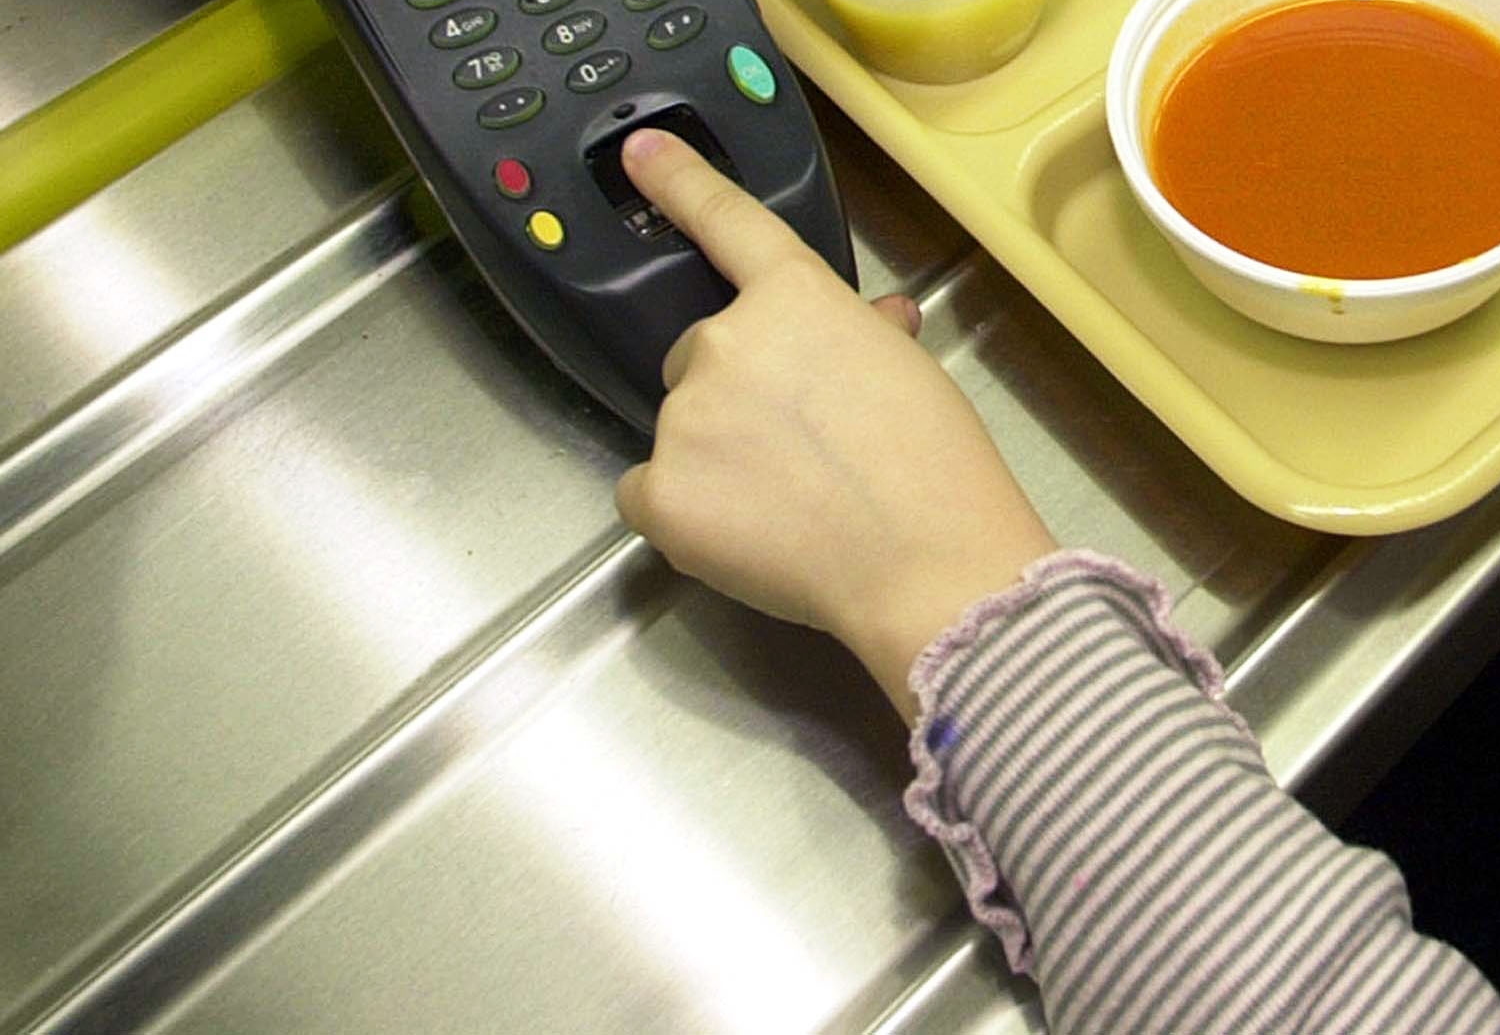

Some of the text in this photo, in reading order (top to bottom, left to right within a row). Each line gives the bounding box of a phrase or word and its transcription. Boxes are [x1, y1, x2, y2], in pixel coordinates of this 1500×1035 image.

[446, 18, 461, 37] 4
[556, 25, 574, 44] 8
[467, 59, 482, 79] 7
[580, 64, 598, 83] 0
